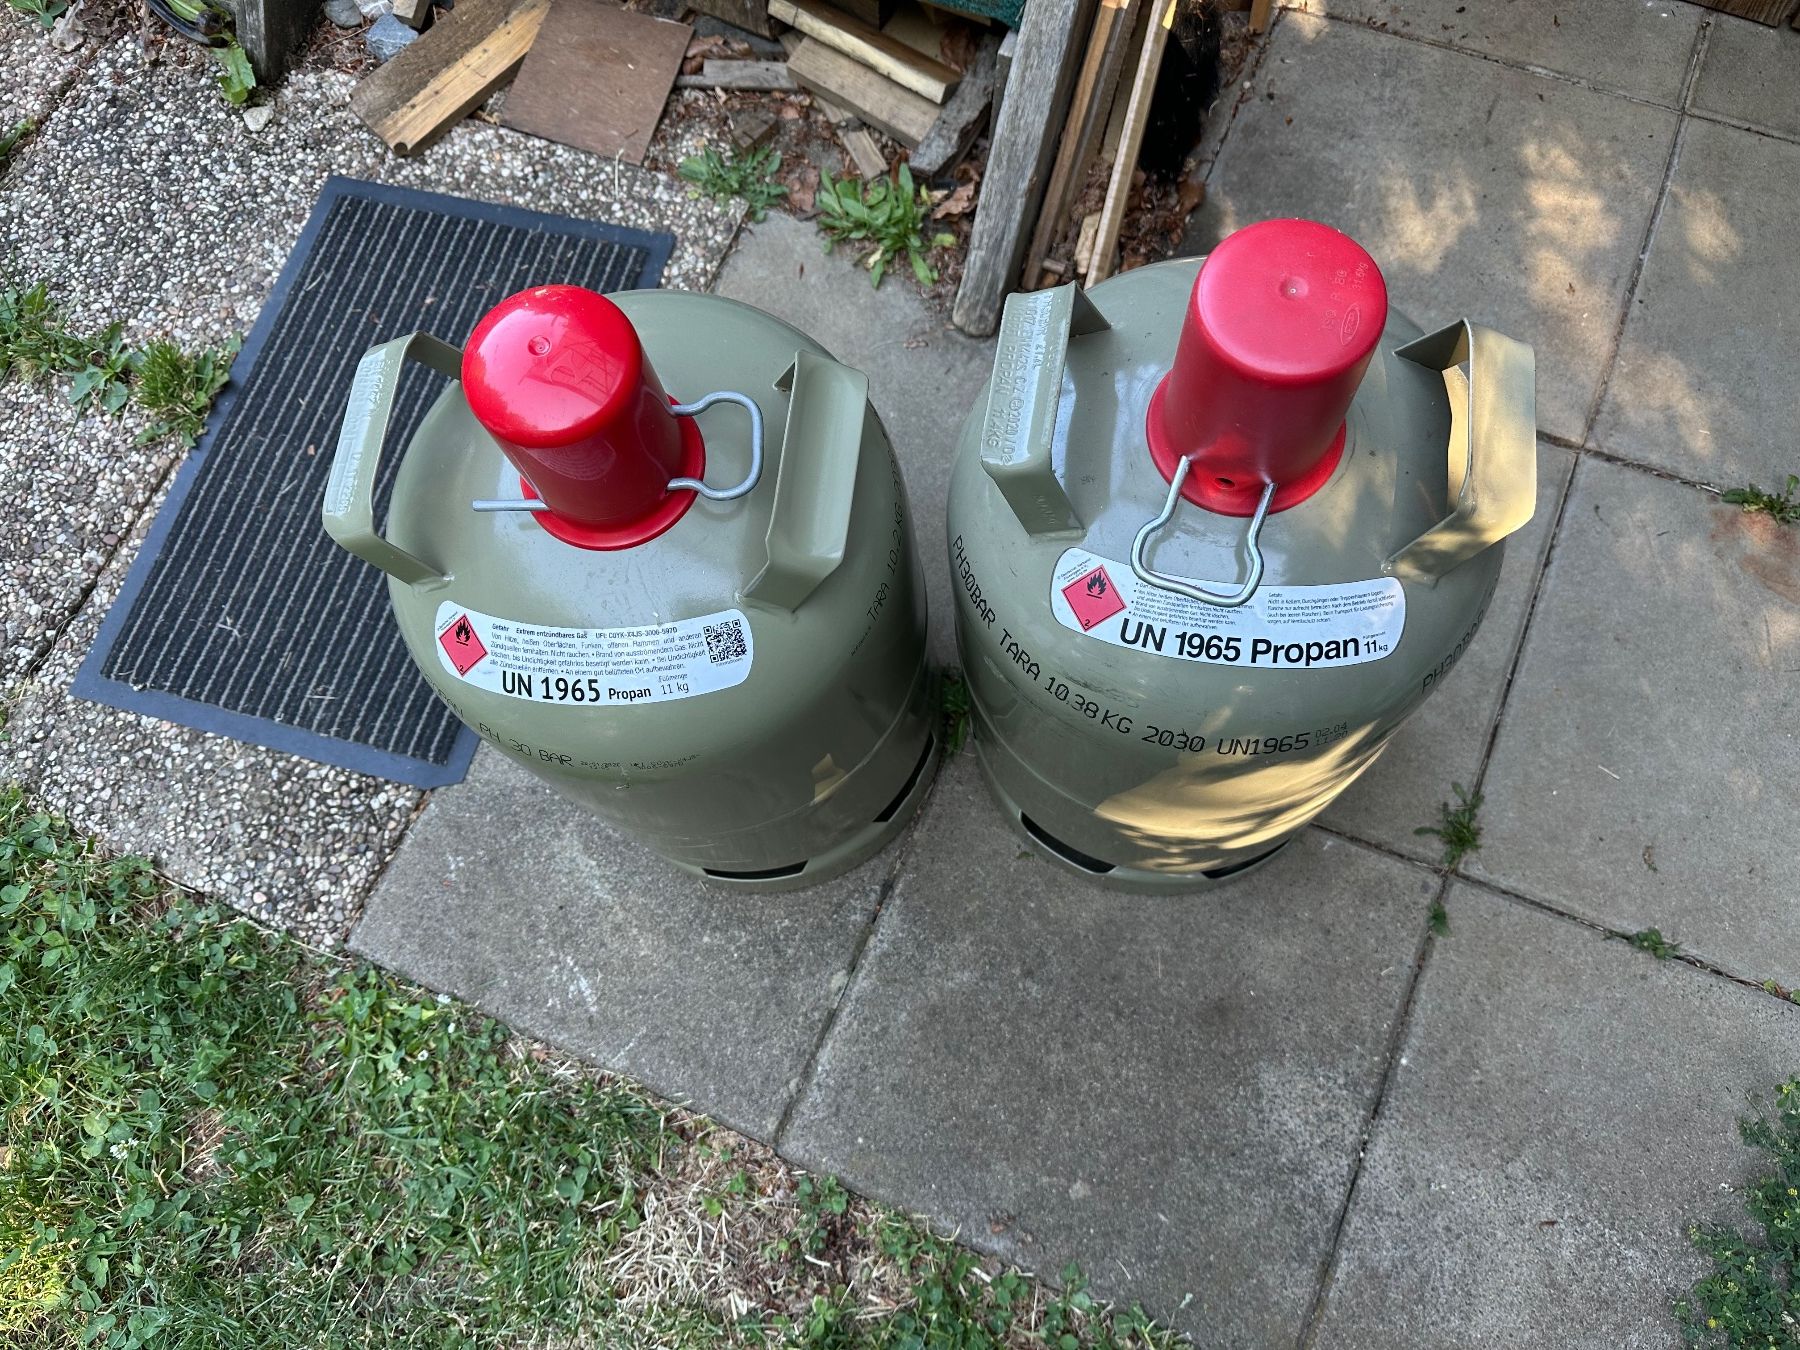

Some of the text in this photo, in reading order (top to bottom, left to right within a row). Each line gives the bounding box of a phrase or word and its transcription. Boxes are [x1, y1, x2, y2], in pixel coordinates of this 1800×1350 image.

[866, 582, 890, 622] TARA
[1119, 617, 1167, 652] UN
[1175, 631, 1242, 662] 1965
[1250, 637, 1360, 667] Propan
[1363, 640, 1377, 654] 11
[502, 670, 689, 703] UN 1965 Propan 11 kg
[999, 628, 1041, 681] TARA
[1141, 725, 1206, 752] 2030
[1216, 732, 1311, 756] UN1965
[479, 722, 501, 743] PH
[538, 749, 575, 768] BAR
